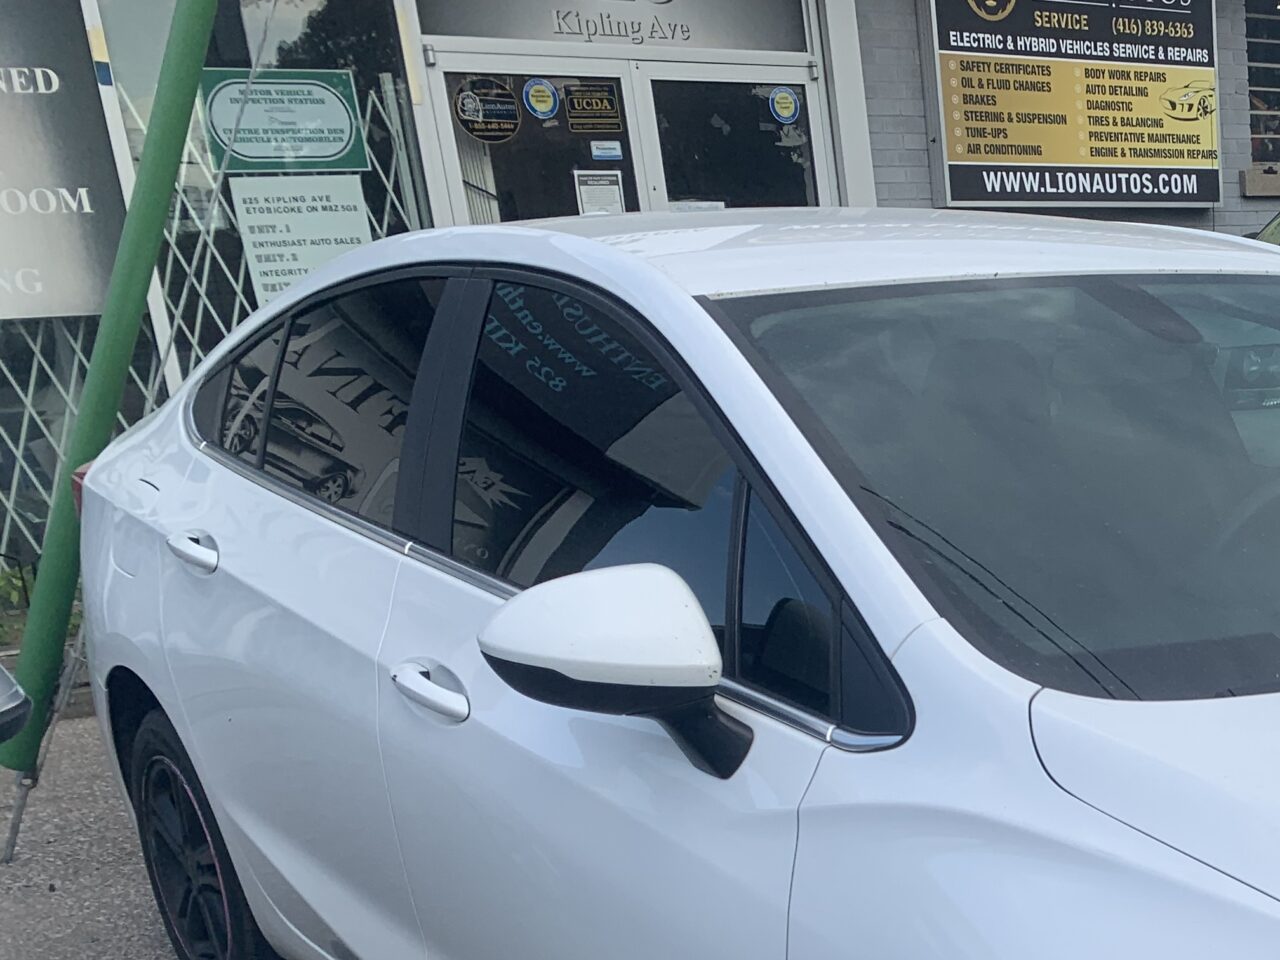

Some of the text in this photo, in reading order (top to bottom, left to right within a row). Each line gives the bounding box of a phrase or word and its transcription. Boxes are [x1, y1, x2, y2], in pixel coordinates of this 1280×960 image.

[553, 9, 690, 45] Kipling Ave
[1034, 11, 1089, 31] SERVICE
[1112, 17, 1194, 39] (416) 839-6363
[949, 30, 1209, 63] ELECTRIC & HYBRID VEHICLES SERVICE & REPAIRS
[960, 60, 1051, 77] SAFETY CERTIFICATES
[1084, 68, 1167, 83] BODY WORK REPAIRS
[961, 78, 1052, 93] OIL & FLUID CHANGES
[1085, 83, 1149, 97] AUTO DETAILING
[573, 98, 612, 110] UCDA
[962, 93, 997, 106] BRAKES
[1086, 99, 1133, 112] DIAGNOSTIC
[963, 110, 1067, 126] STEERING & SUSPENSION
[1087, 115, 1164, 128] TIRES & BALANCING
[965, 127, 1008, 139] TUNE-UPS
[1088, 131, 1201, 144] PREVENTATIVE MAINTENANCE
[967, 144, 1042, 156] AIR CONDITIONING
[1090, 146, 1218, 160] ENGINE & TRANSMISSION REPAIRS
[983, 170, 1198, 194] WWW.LIONAUTOS.COM
[242, 194, 331, 205] 825 KIPLING AVE
[245, 205, 303, 214] ETOBICOKE
[252, 237, 361, 248] ENTHUSIAST AUTO SALES
[260, 268, 309, 277] INTEGRITY
